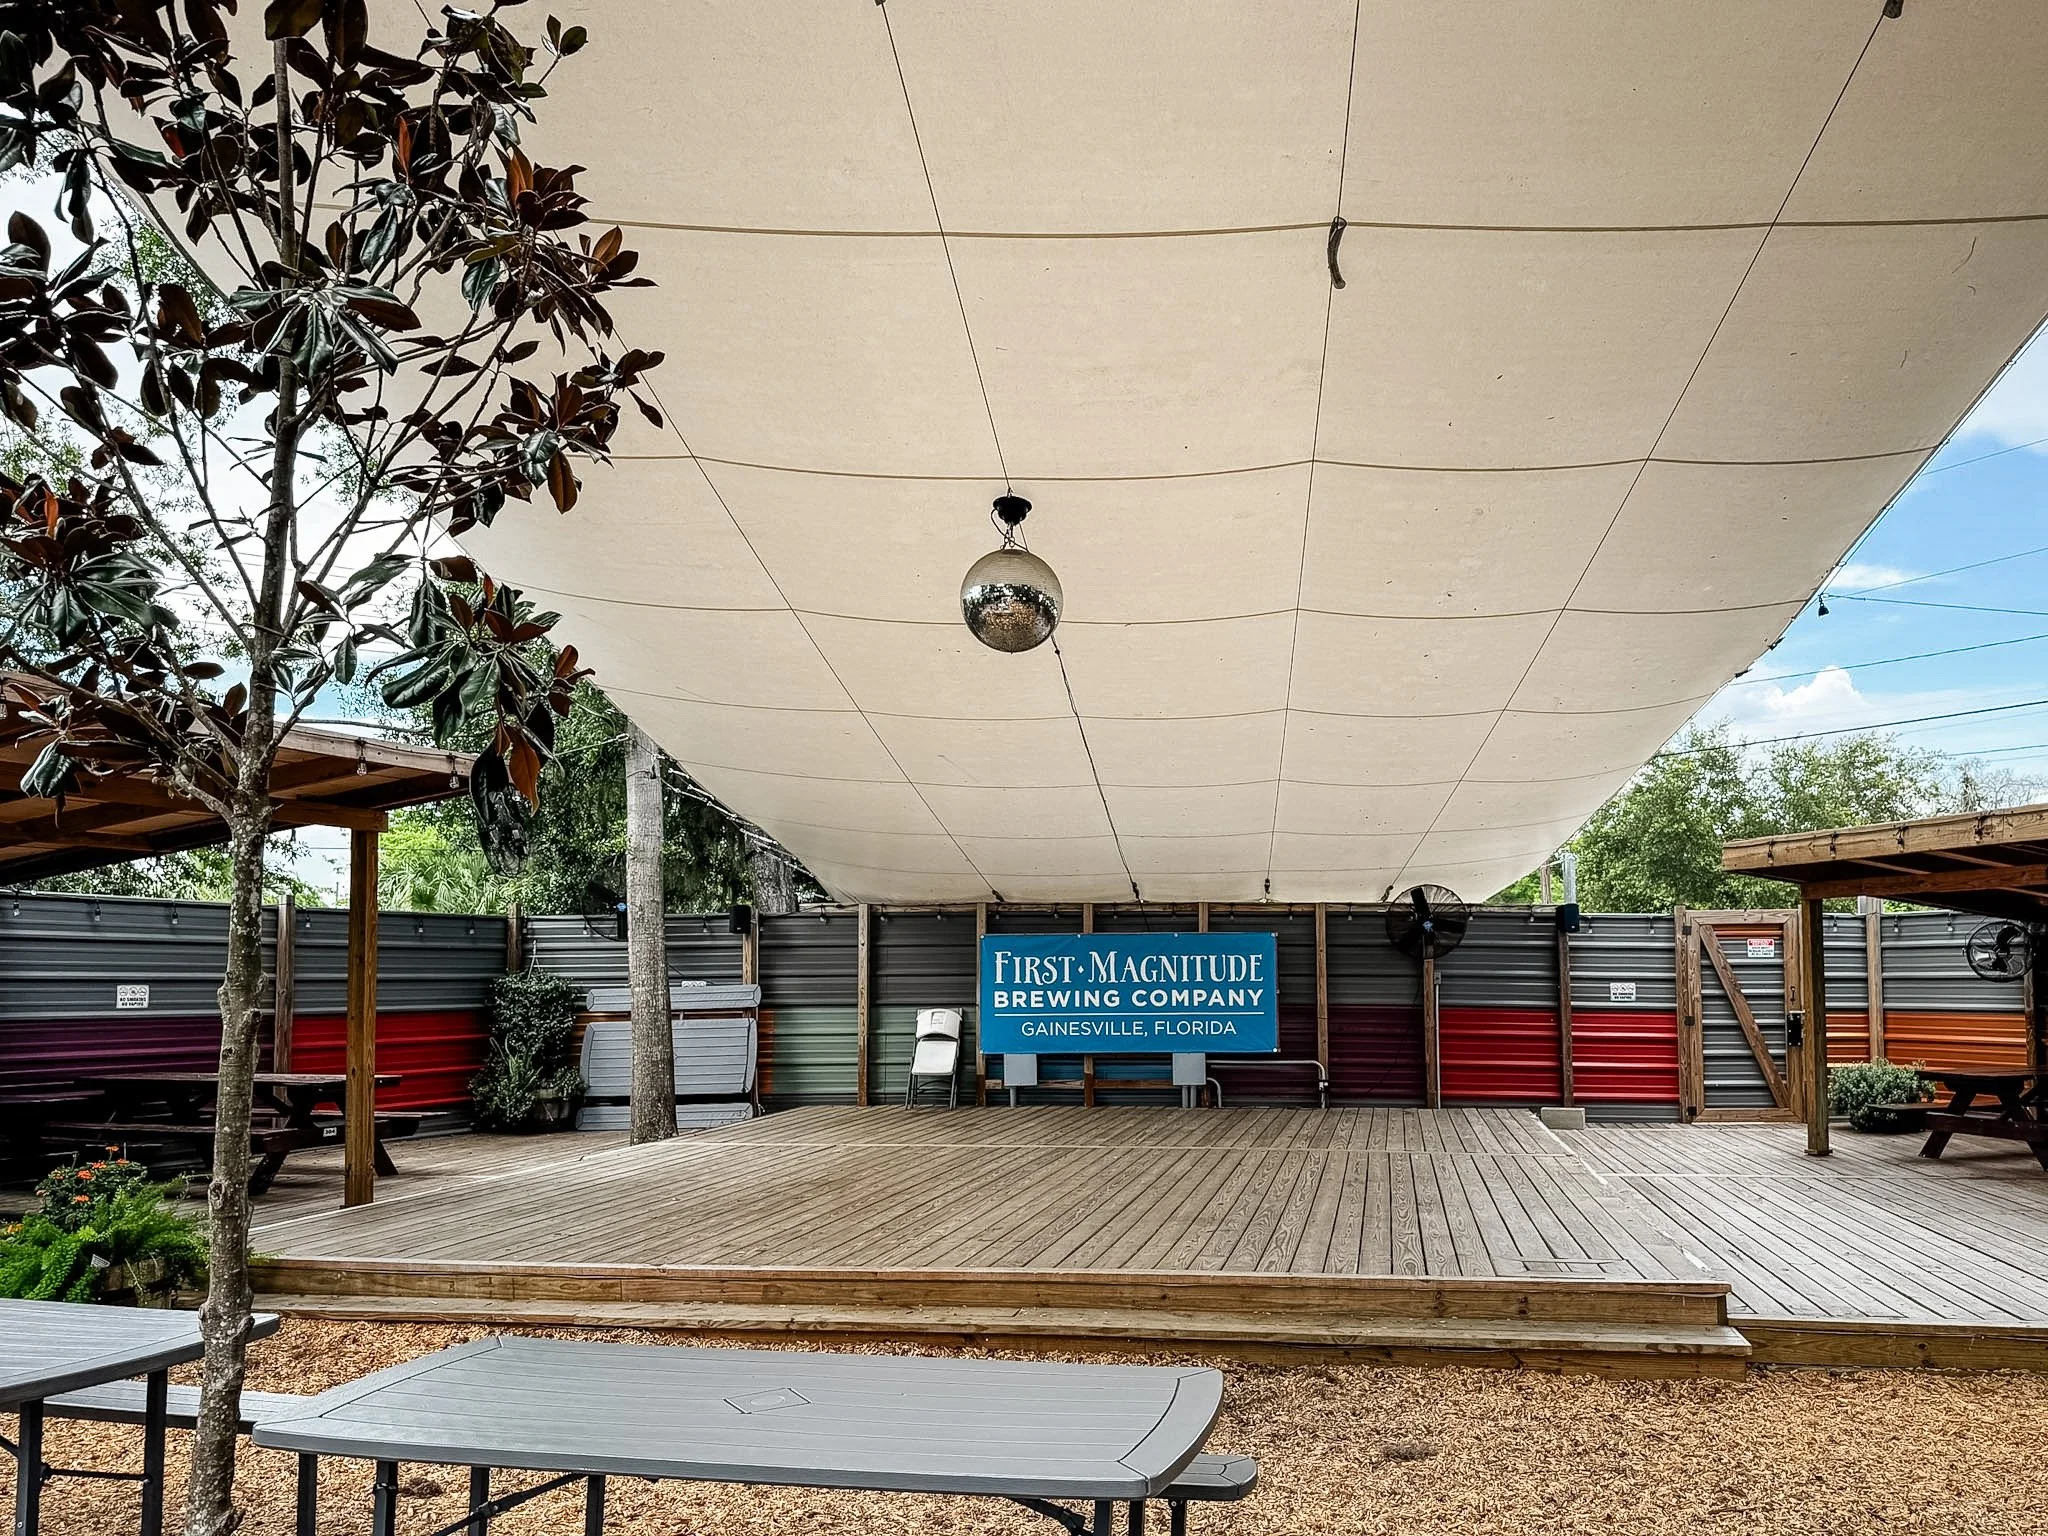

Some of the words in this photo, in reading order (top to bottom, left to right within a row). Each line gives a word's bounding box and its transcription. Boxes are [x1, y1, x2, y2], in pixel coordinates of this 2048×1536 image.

[994, 990, 1120, 1008] BREWING
[1131, 989, 1264, 1007] COMPANY
[1021, 1021, 1148, 1037] GAINESVILLE,
[1155, 1021, 1237, 1035] FLORIDA
